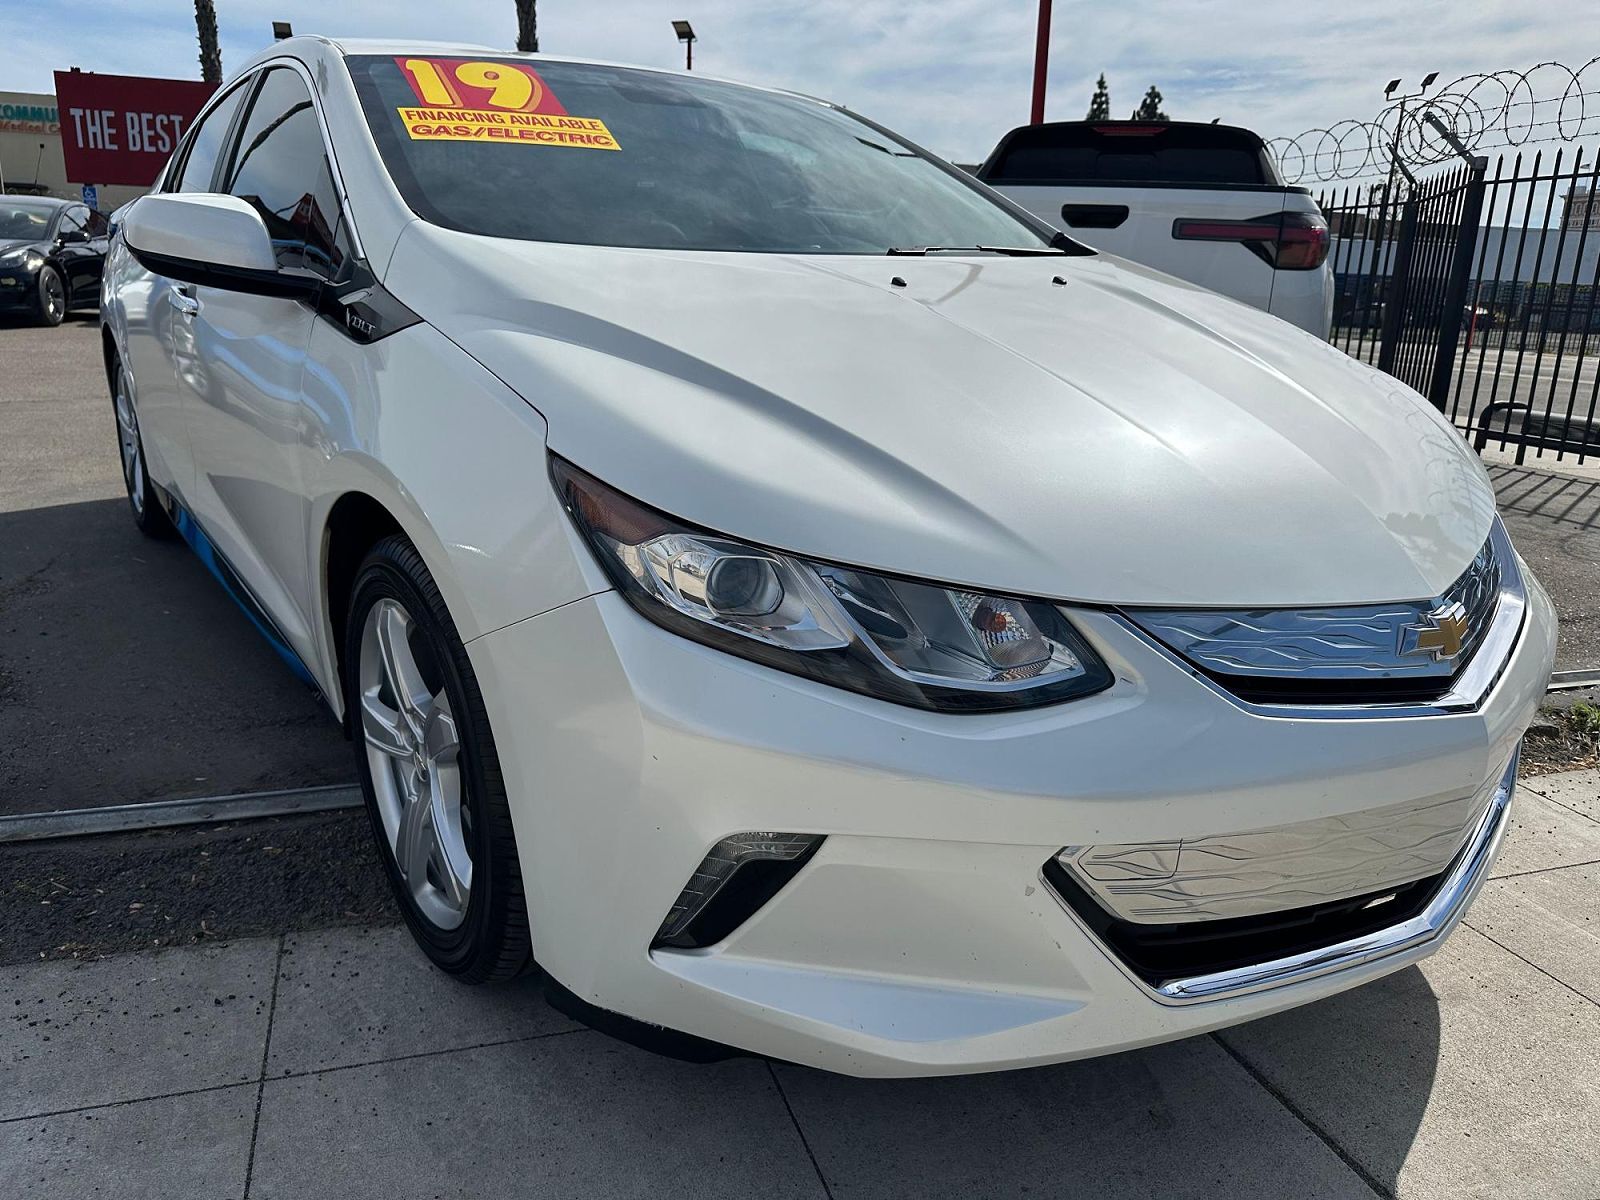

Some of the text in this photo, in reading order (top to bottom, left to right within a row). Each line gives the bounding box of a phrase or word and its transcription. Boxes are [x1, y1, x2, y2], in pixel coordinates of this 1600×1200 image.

[405, 59, 543, 112] 19
[70, 108, 184, 153] THE BEST
[406, 110, 600, 131] FINANCING AVAILABLE
[411, 125, 614, 146] GAS/ELECTRIC
[346, 307, 376, 335] VOLT
